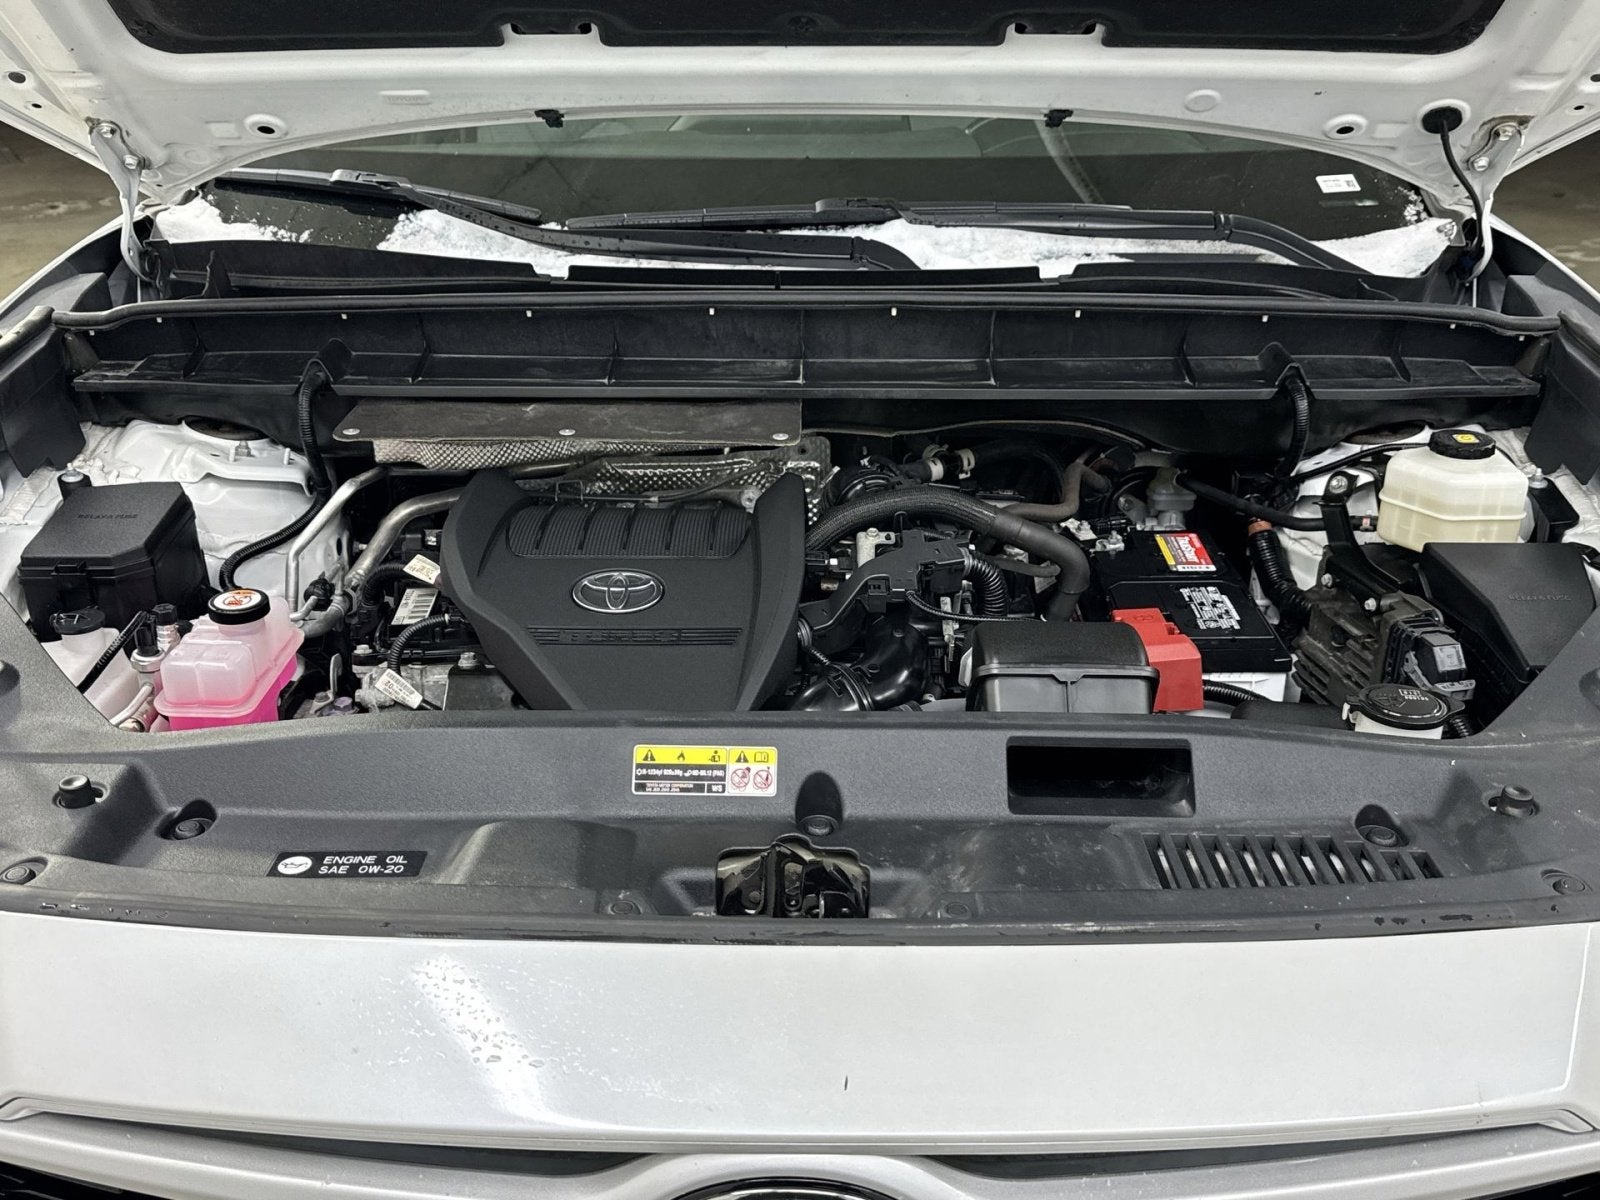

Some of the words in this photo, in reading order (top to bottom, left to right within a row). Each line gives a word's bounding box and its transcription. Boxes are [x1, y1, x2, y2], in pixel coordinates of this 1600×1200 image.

[323, 855, 377, 864] ENGINE
[386, 855, 408, 864] OIL
[318, 865, 350, 874] SAE
[358, 865, 404, 874] 0W-20
